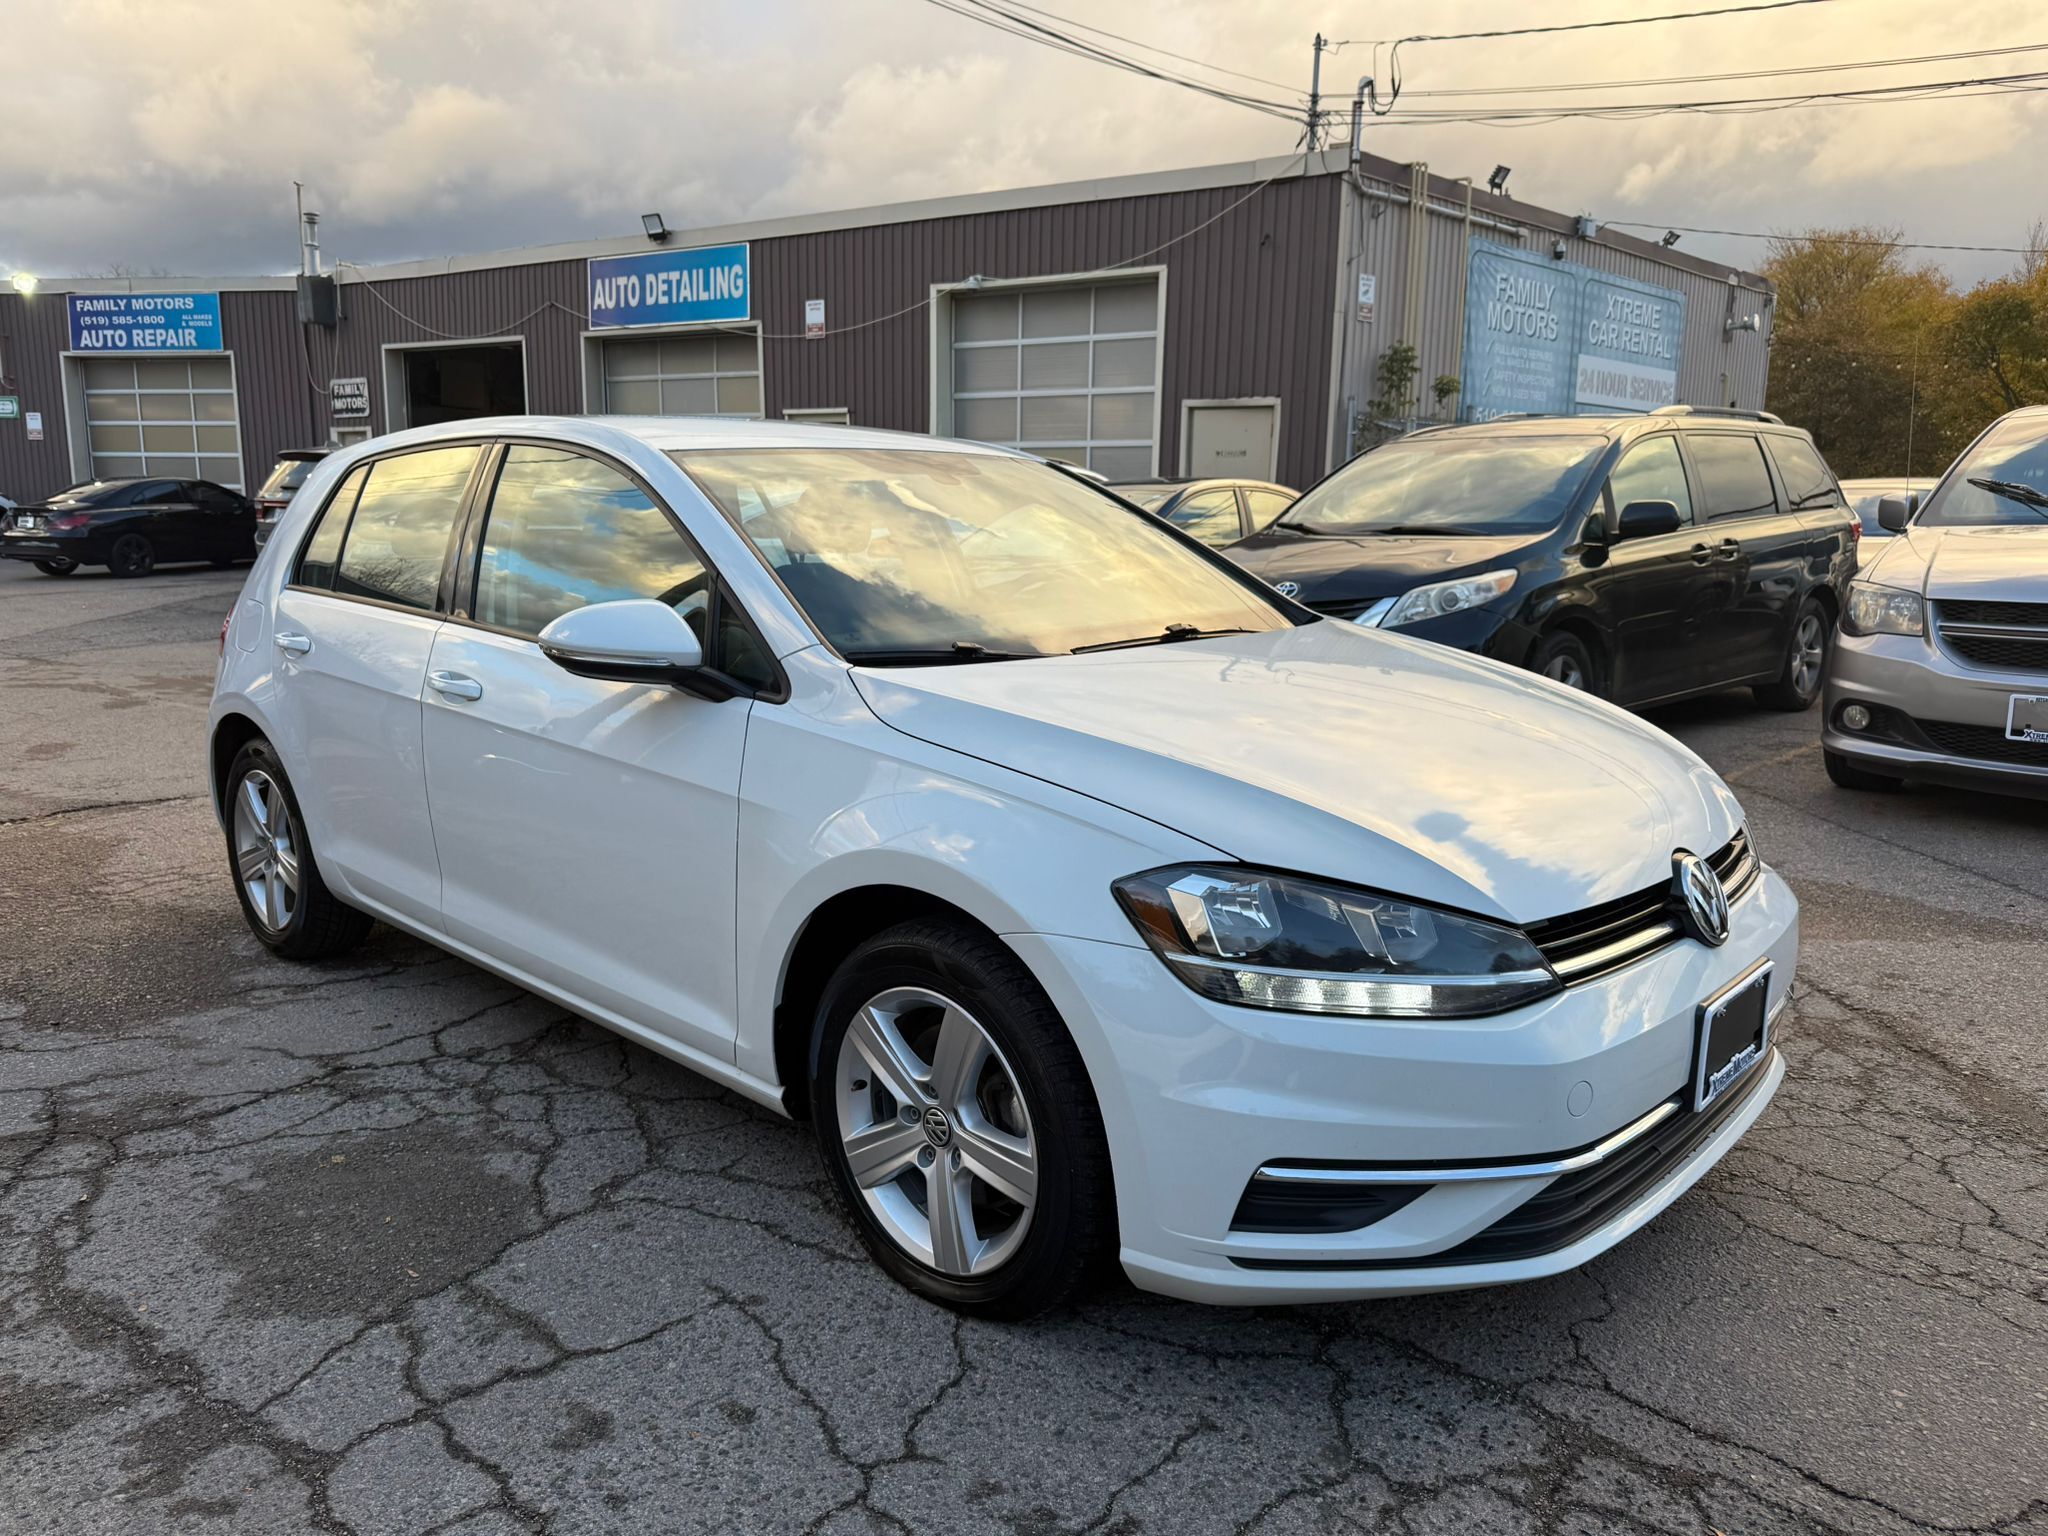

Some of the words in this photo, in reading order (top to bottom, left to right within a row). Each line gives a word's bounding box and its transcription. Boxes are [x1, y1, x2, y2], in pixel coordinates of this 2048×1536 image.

[76, 299, 127, 312] FAMILY
[131, 297, 194, 310] MOTORS
[594, 274, 640, 310] AUTO
[645, 264, 743, 306] DETAILING
[1497, 273, 1556, 312] FAMILY
[80, 316, 109, 327] (519)
[112, 315, 165, 325] 585-1800
[1487, 301, 1559, 342] MOTORS
[1605, 293, 1662, 331] XTREME
[80, 329, 127, 348] AUTO
[132, 328, 198, 347] REPAIR
[1589, 319, 1620, 351] CAR
[1621, 326, 1672, 361] RENTAL
[334, 383, 366, 396] FAMILY
[334, 396, 368, 410] MOTORS
[1579, 367, 1595, 394] 24
[1596, 370, 1628, 399] HOUR
[1630, 376, 1674, 406] SERVICE
